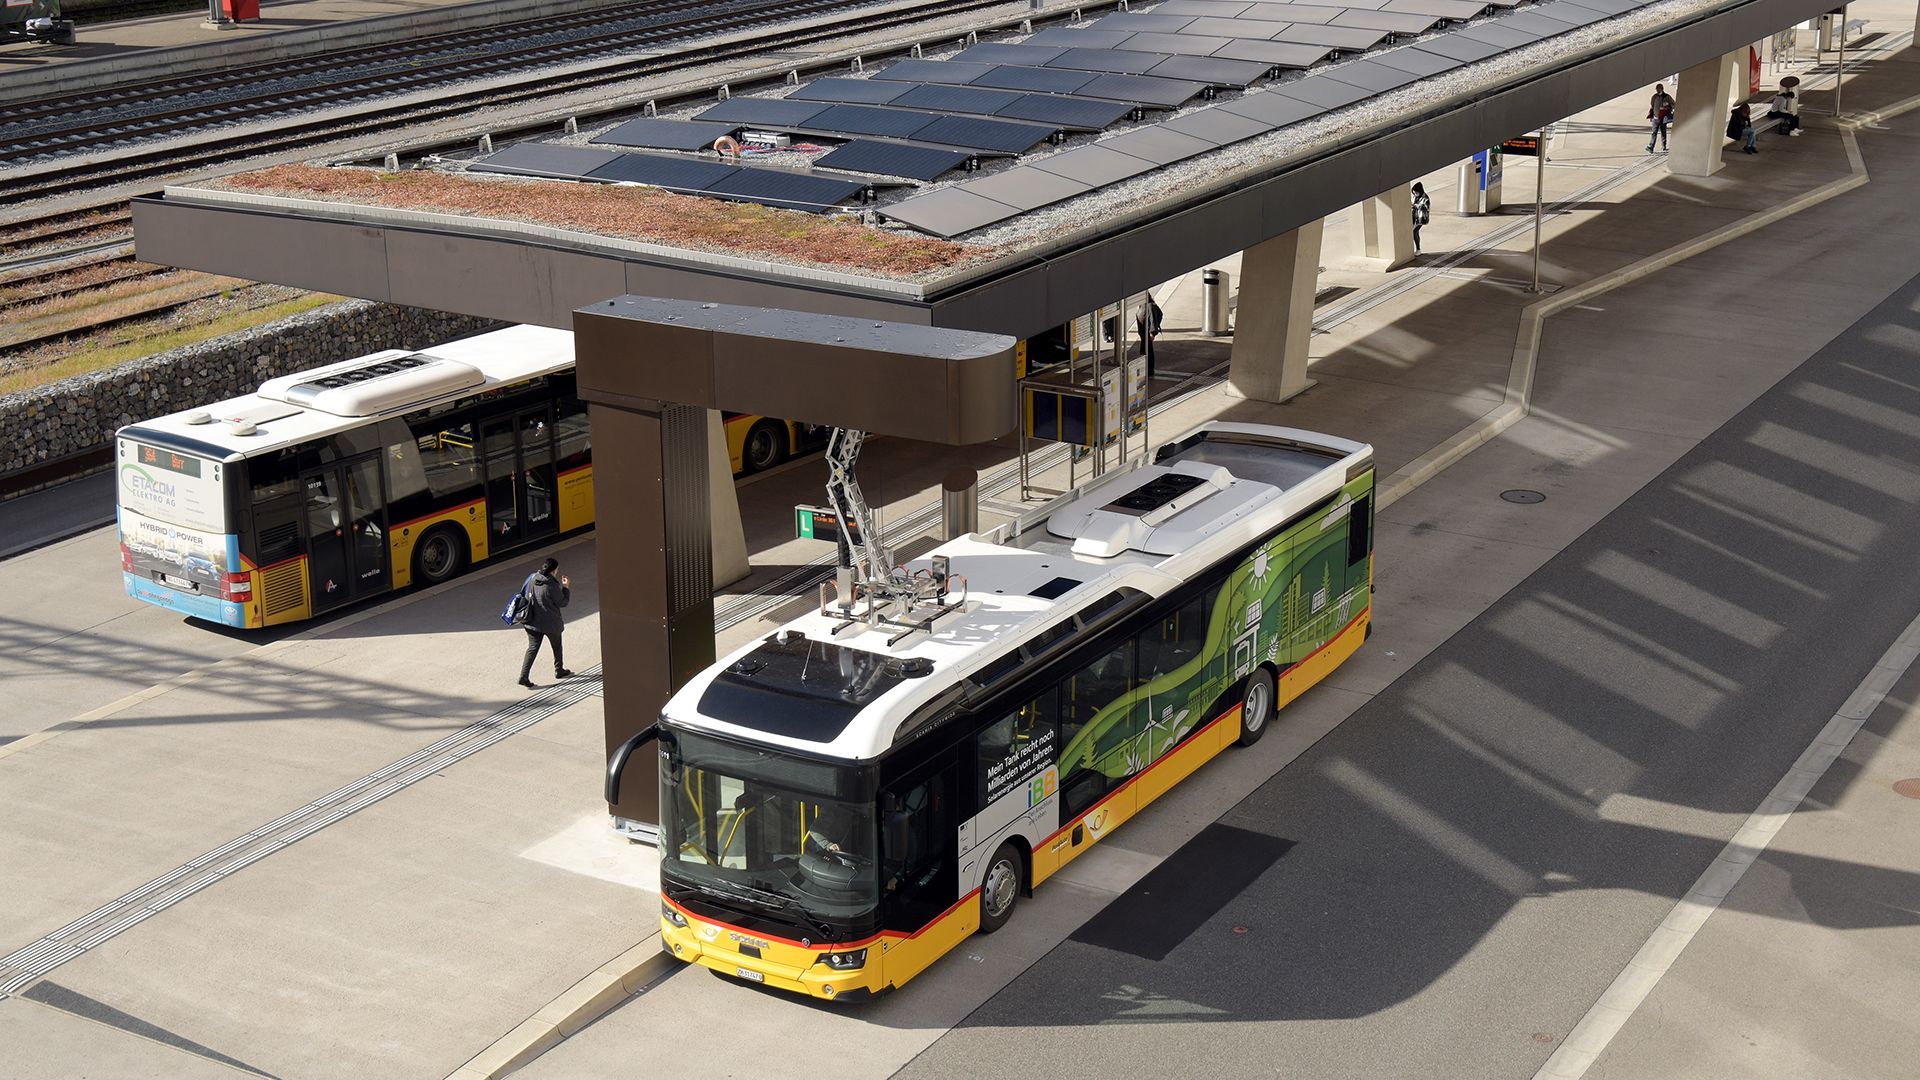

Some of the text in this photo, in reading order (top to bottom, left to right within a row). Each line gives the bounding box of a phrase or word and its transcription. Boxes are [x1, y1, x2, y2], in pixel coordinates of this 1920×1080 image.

[132, 474, 175, 498] ETACOM
[132, 488, 163, 504] ELEKTRO
[166, 497, 176, 508] AG
[139, 521, 168, 536] HYBRID
[176, 531, 204, 545] POWER
[801, 514, 810, 532] L
[361, 568, 381, 579] welle
[987, 728, 1055, 779] Mein Tank reicht noch
[987, 744, 1054, 793] Milliarden von Jahren.
[987, 782, 1014, 804] Solarenergie
[1021, 767, 1037, 781] unserer
[730, 932, 770, 949] SCANIA
